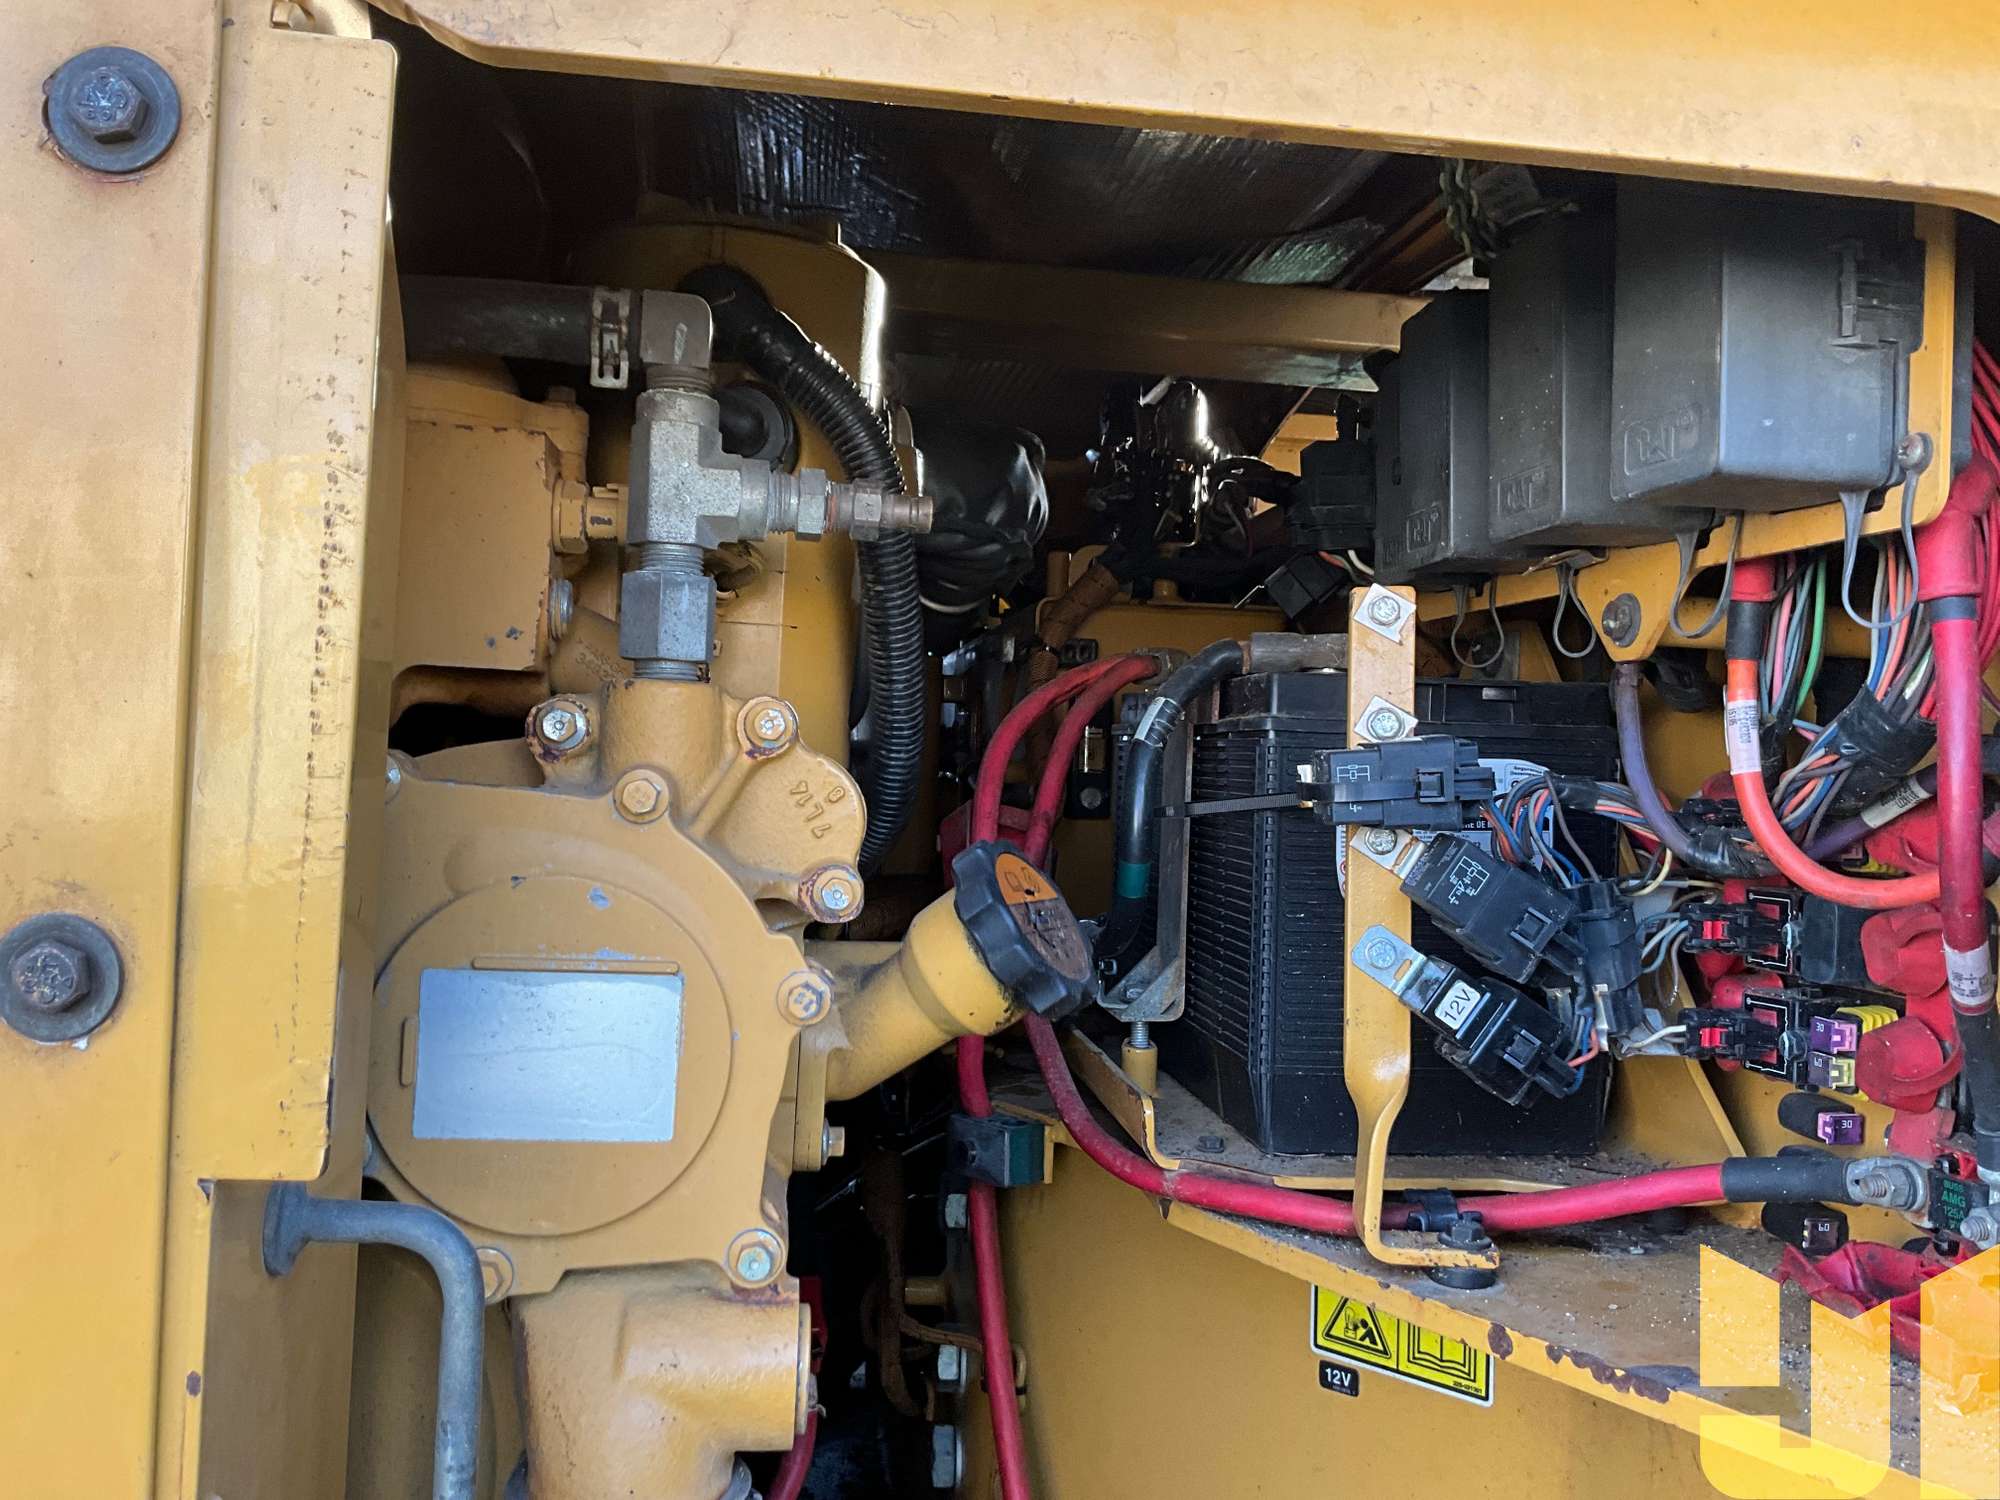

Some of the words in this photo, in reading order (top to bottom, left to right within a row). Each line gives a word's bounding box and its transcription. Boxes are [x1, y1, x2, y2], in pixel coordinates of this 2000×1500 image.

[1443, 988, 1473, 1022] 12V
[1815, 1022, 1825, 1033] 30
[1841, 1119, 1853, 1129] 30
[1941, 1190, 1966, 1208] AMG
[1943, 1205, 1966, 1220] 125A
[1818, 1223, 1830, 1232] 60
[1325, 1367, 1352, 1387] 12V
